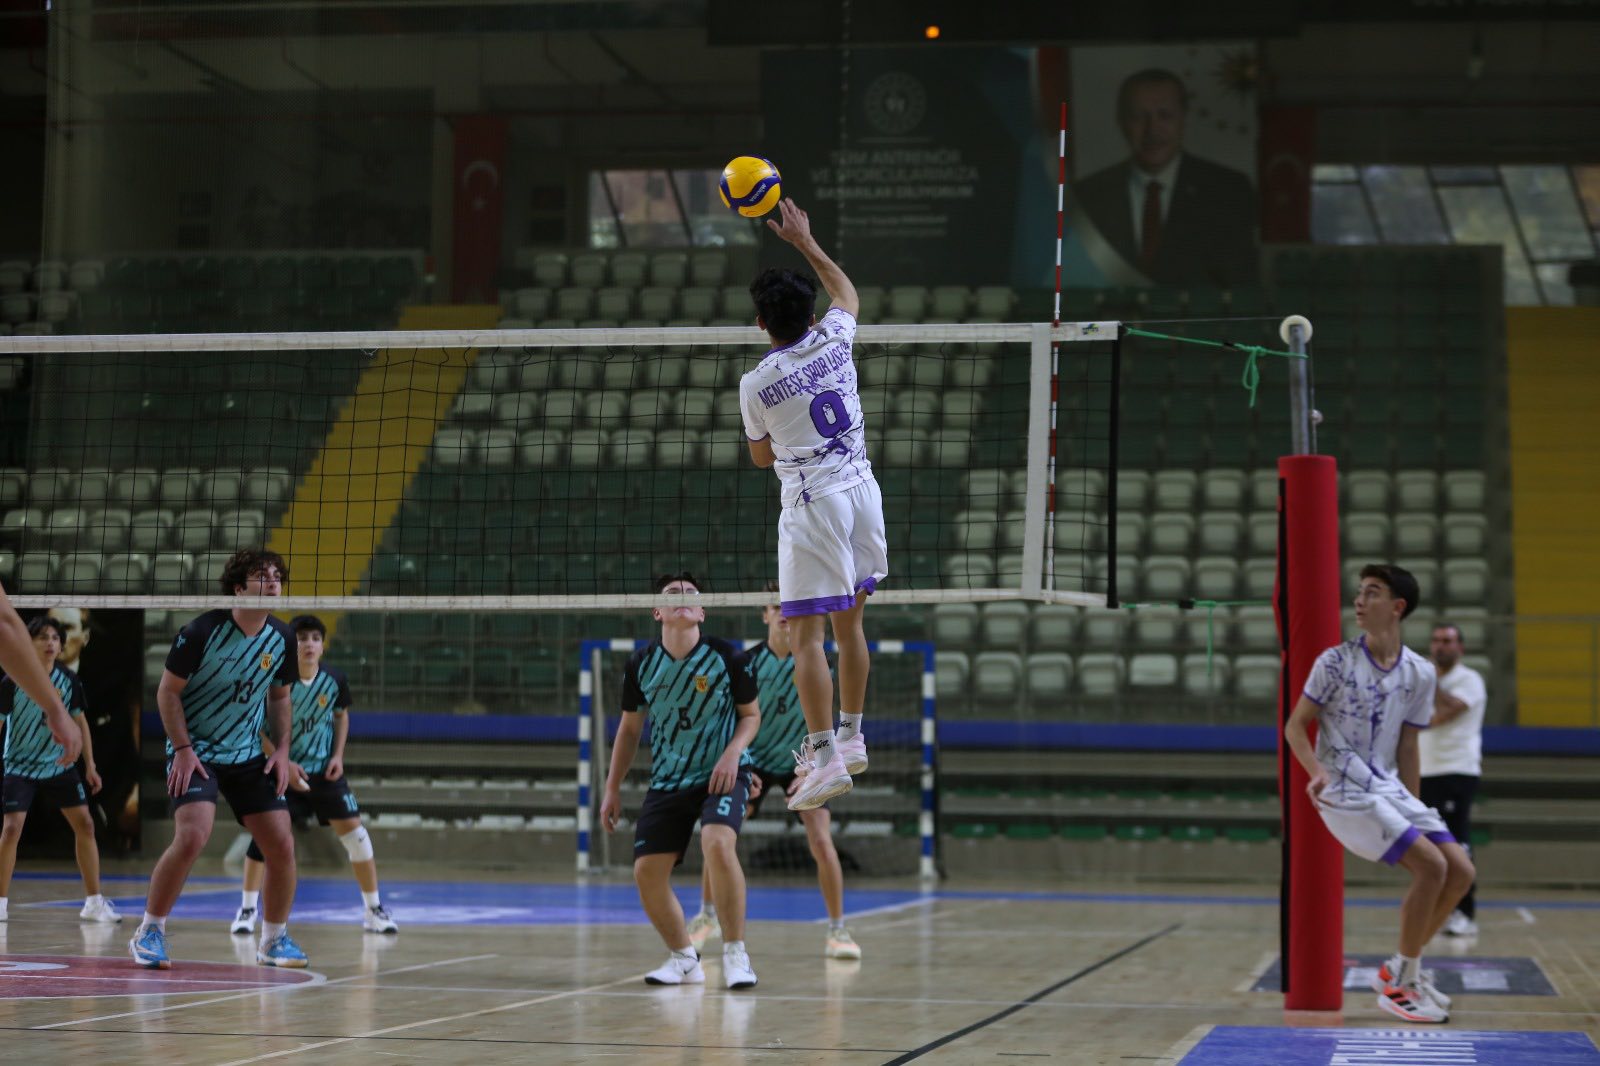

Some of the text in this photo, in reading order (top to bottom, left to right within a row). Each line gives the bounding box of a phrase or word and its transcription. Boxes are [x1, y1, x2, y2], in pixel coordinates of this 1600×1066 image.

[802, 356, 832, 384] SPOR
[232, 680, 254, 704] 13
[717, 796, 733, 816] 5
